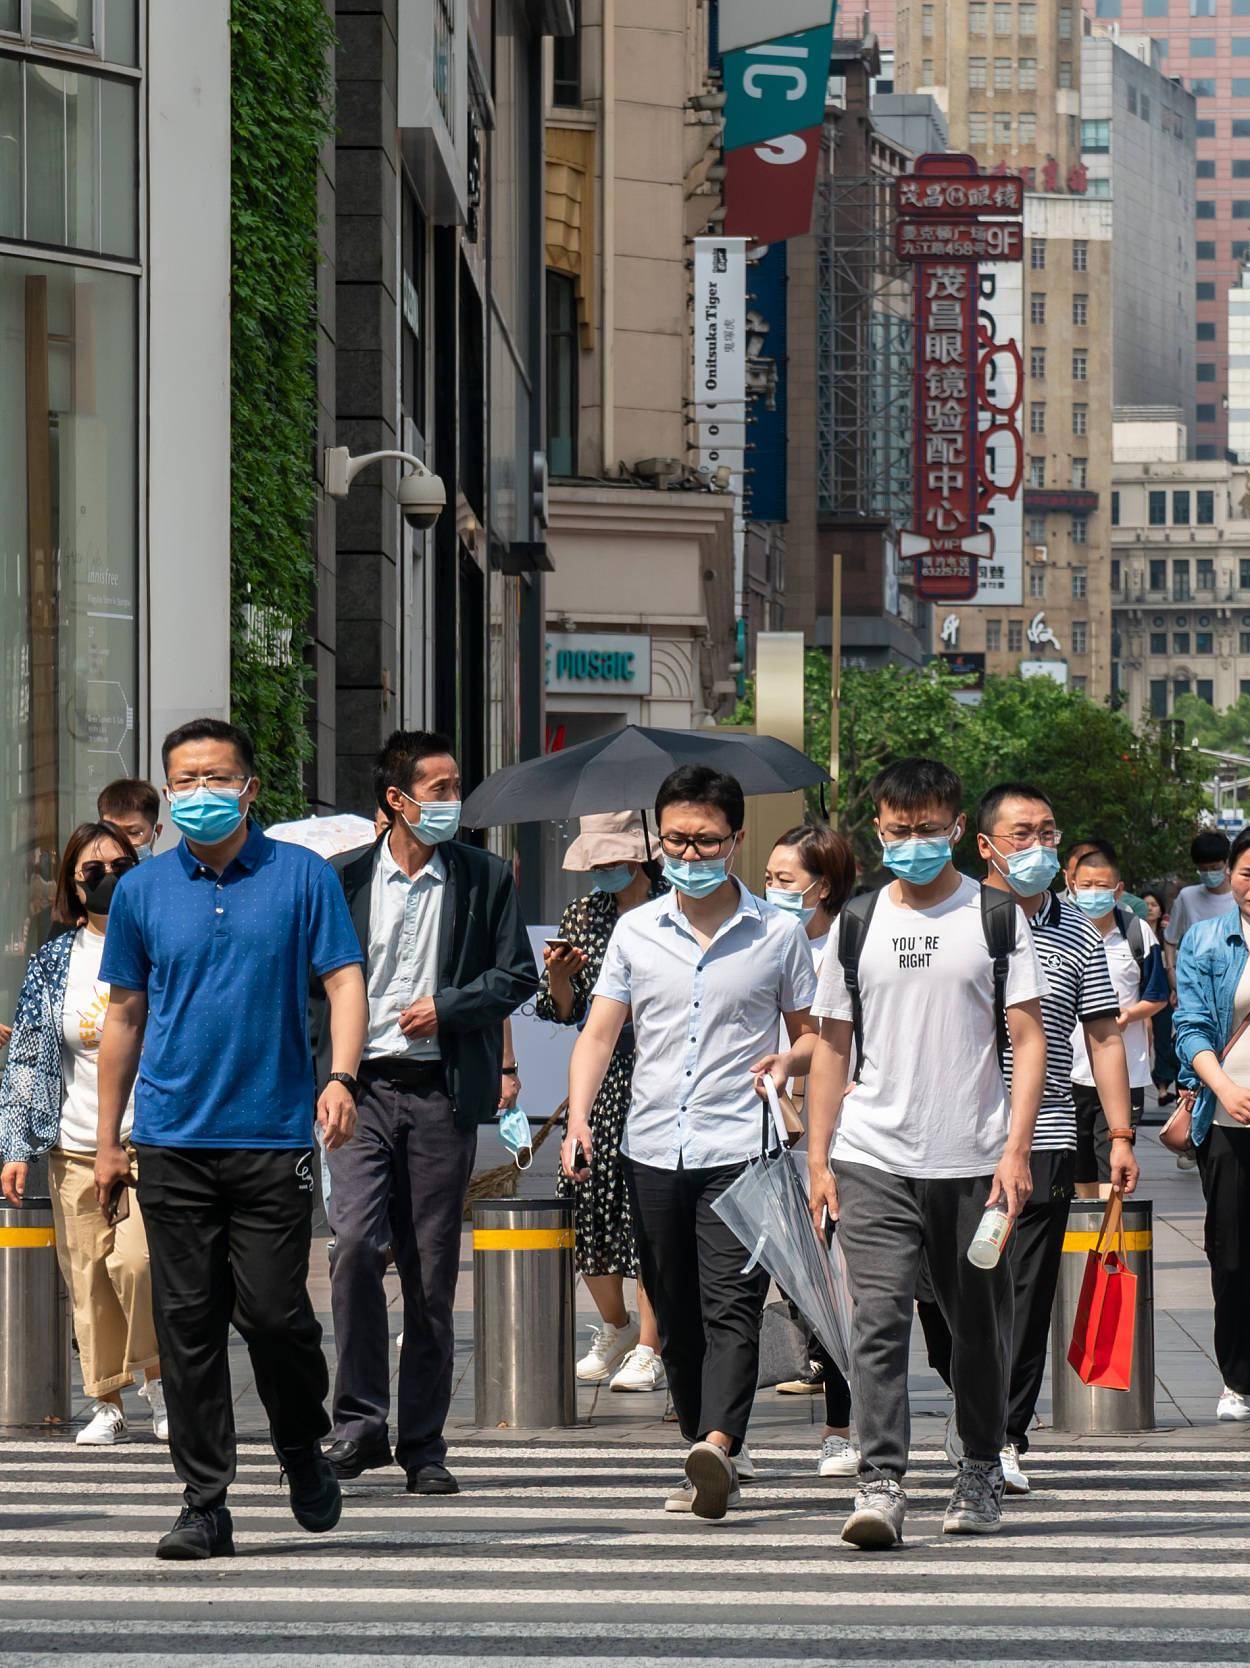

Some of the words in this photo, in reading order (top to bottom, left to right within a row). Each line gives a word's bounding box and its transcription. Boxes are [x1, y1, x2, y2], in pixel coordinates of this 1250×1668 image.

[987, 226, 1019, 254] 9F
[705, 281, 720, 321] Tiger
[705, 323, 717, 391] Onitsuka
[924, 265, 967, 532] 茂昌眼镜验配中心
[932, 539, 959, 549] VIP
[899, 954, 931, 968] RIGHT
